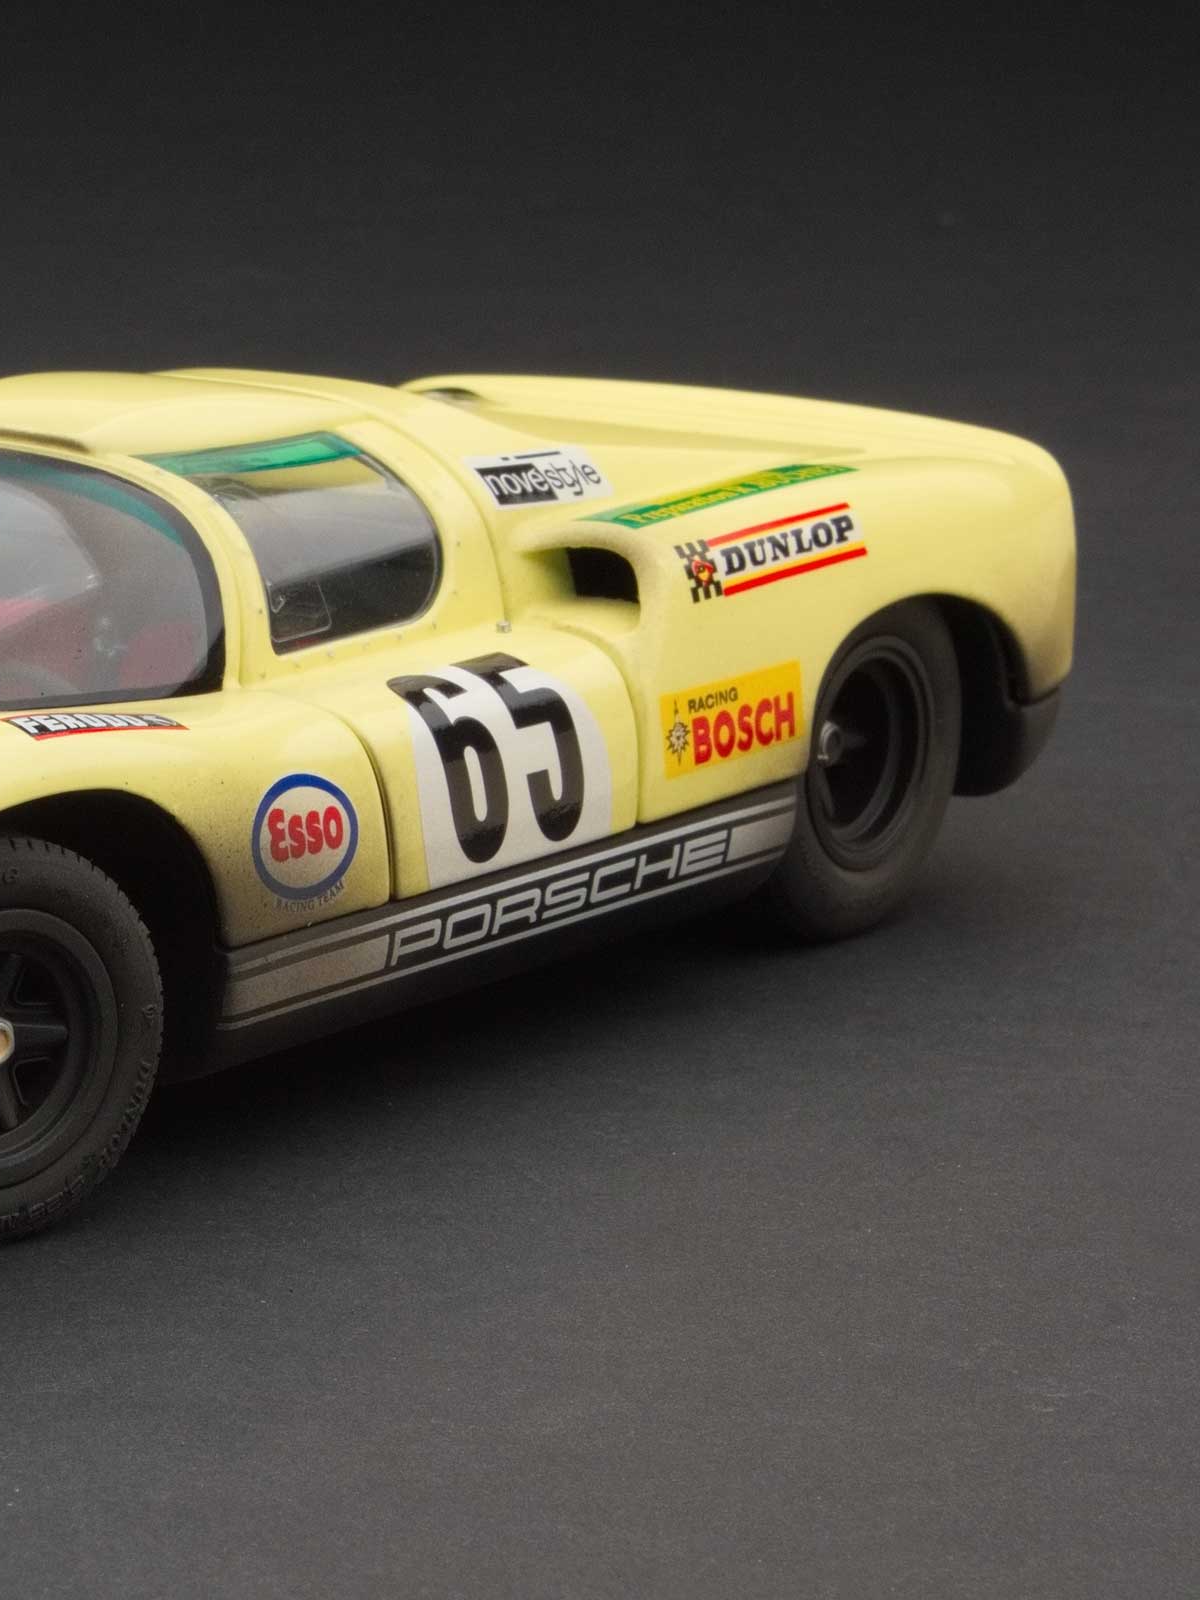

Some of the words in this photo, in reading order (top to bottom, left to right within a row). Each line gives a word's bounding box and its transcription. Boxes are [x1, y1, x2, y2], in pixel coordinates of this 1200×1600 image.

[720, 514, 854, 576] DUNLOP
[9, 713, 149, 734] FERODO
[688, 686, 739, 713] RACING
[692, 691, 796, 766] BOSCH
[387, 651, 585, 864] 65
[390, 828, 734, 967] PORSCHE
